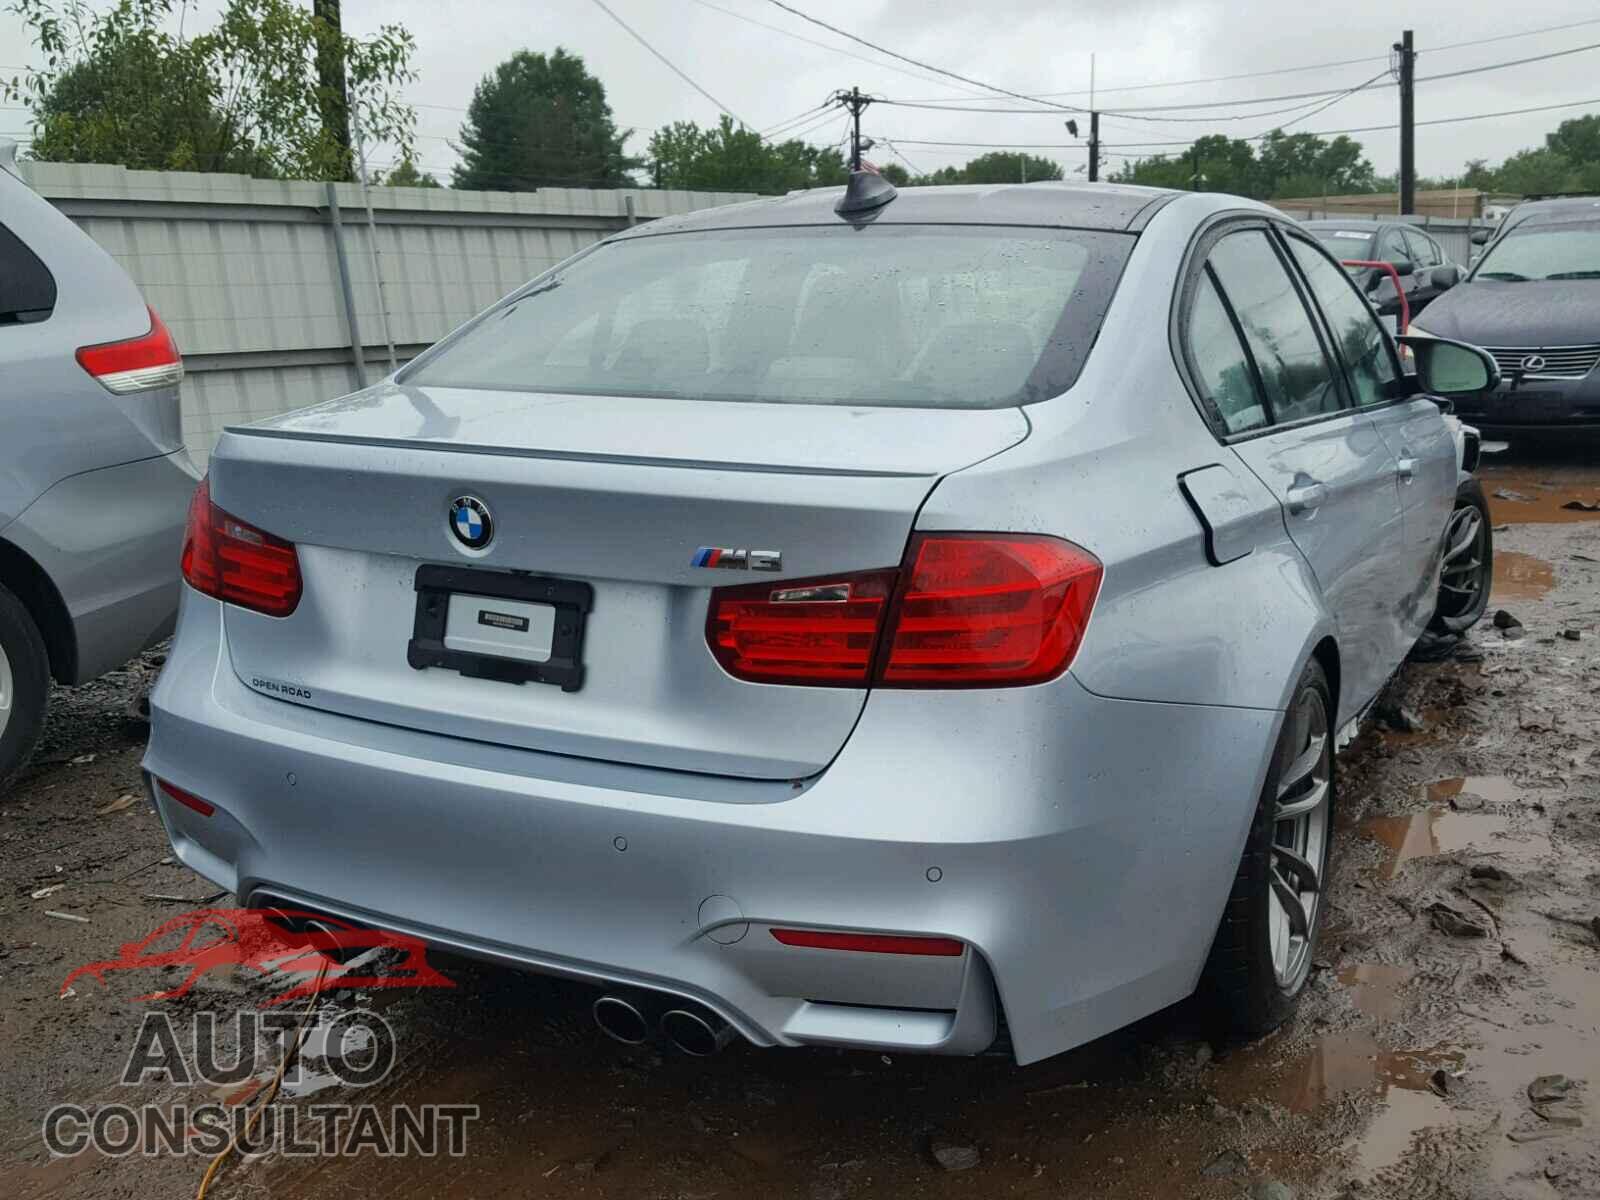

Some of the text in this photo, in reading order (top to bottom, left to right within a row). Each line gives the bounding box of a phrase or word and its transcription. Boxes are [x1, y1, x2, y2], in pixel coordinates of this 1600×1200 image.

[706, 547, 783, 572] M3
[252, 678, 312, 699] OPEN ROAD
